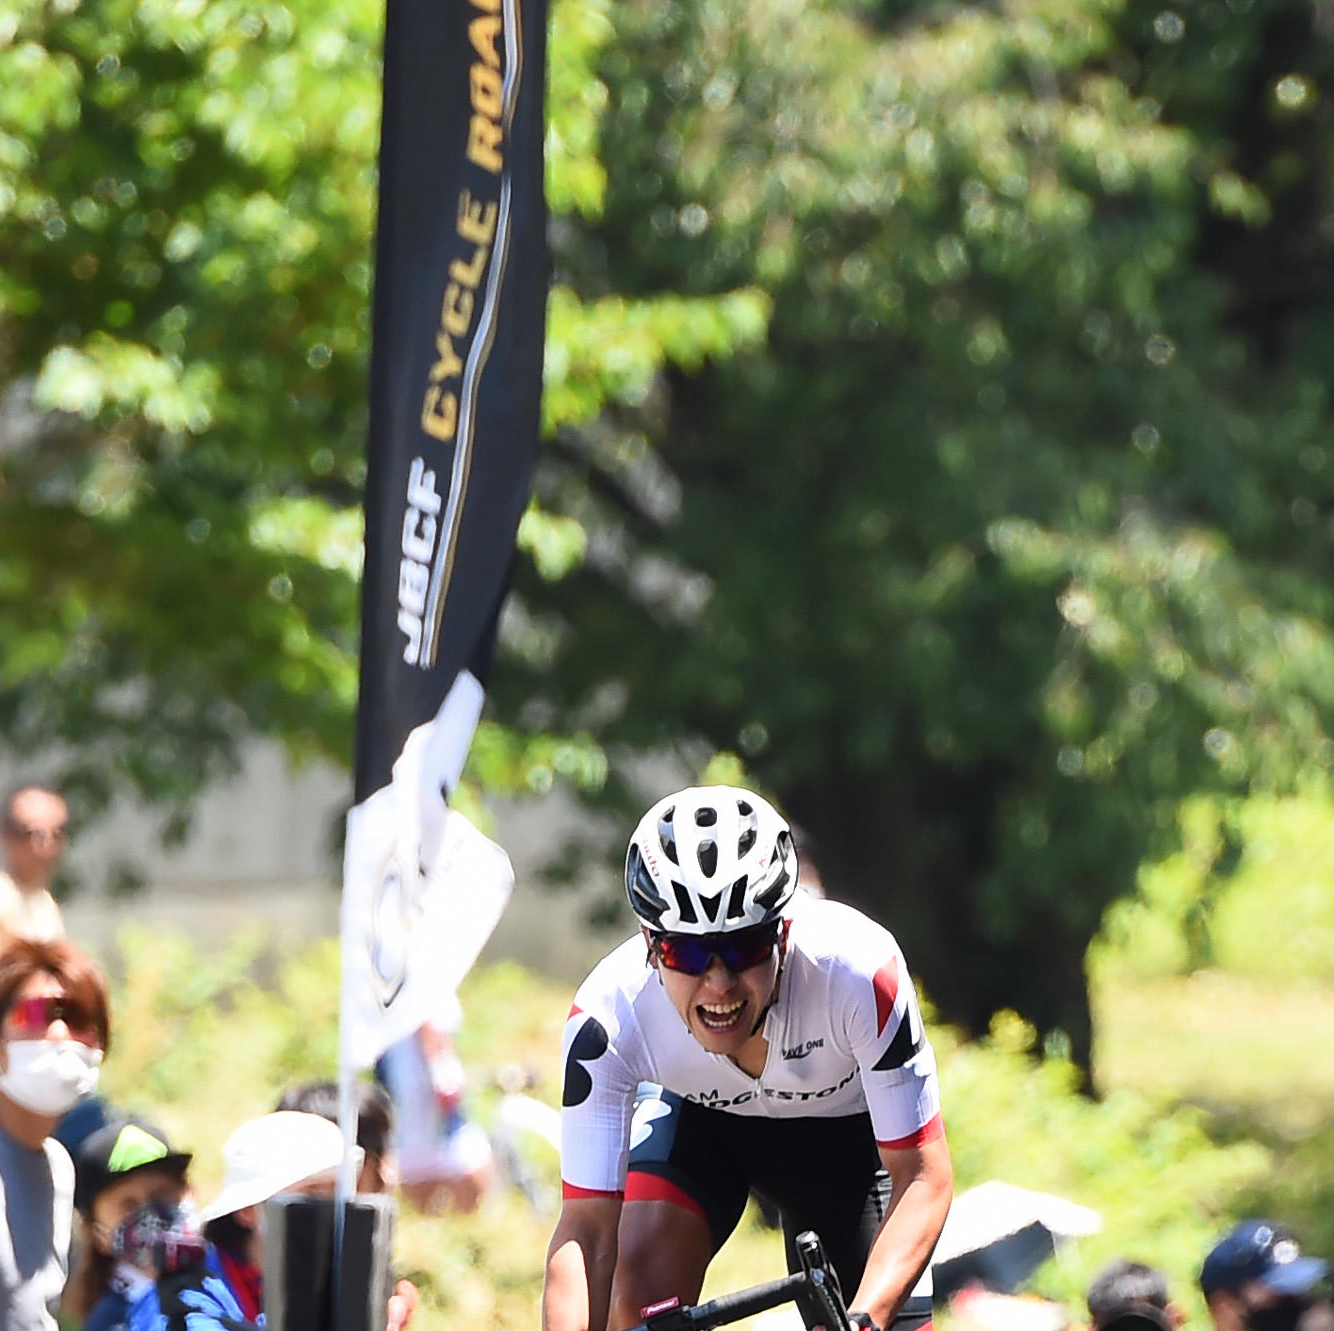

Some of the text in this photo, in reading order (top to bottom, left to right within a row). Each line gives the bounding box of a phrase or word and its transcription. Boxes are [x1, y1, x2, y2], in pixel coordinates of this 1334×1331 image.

[397, 0, 503, 666] JBCF CYCLE ROA
